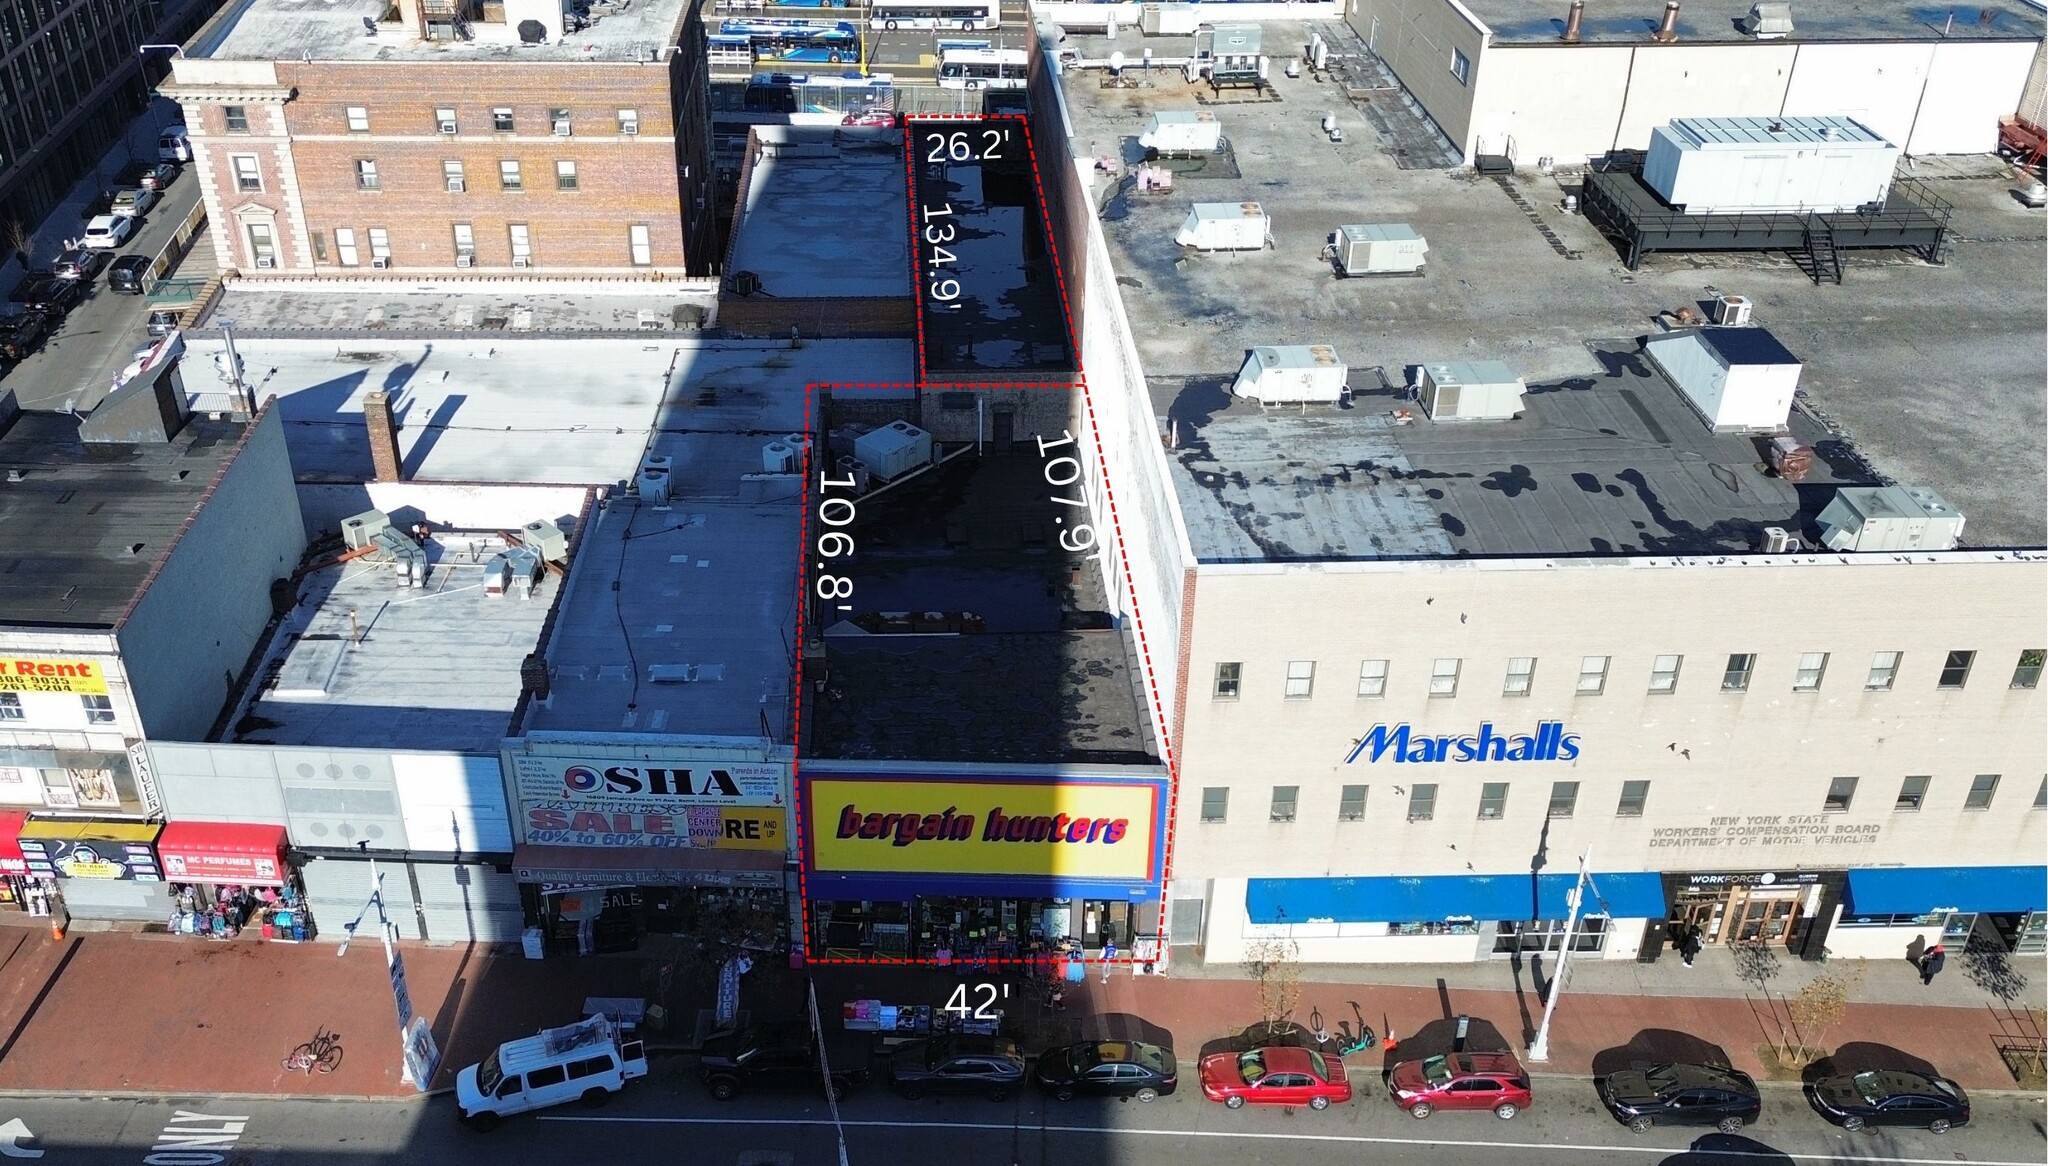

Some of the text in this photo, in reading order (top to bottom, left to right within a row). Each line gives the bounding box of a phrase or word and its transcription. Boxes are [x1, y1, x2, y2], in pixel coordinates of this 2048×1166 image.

[15, 661, 92, 677] Rent
[1344, 720, 1581, 763] Marshalls
[565, 764, 743, 797] OSHA
[529, 810, 675, 835] SALE
[688, 818, 721, 827] CENTER
[764, 821, 777, 829] AND
[836, 804, 1129, 847] bargain hunters
[1710, 815, 1830, 826] NEW YORK STATE
[688, 828, 721, 837] DOWN
[721, 819, 760, 839] RE
[1653, 824, 1880, 837] WORKERS' COMPENSATION BOARD
[528, 830, 569, 843] 40%
[576, 832, 596, 844] to
[602, 833, 644, 846] 60%
[650, 835, 689, 848] OFF
[1649, 837, 1736, 847] DEPARTMENT
[1739, 836, 1757, 846] OF
[1814, 835, 1877, 844] VEHICLES
[187, 856, 252, 865] MC PERFUMES
[536, 871, 572, 882] Quality
[577, 871, 621, 881] Furniture
[625, 872, 633, 881] &
[1691, 875, 1761, 884] WORKFORCE
[602, 893, 640, 908] SALE
[143, 1110, 250, 1165] ONLY
